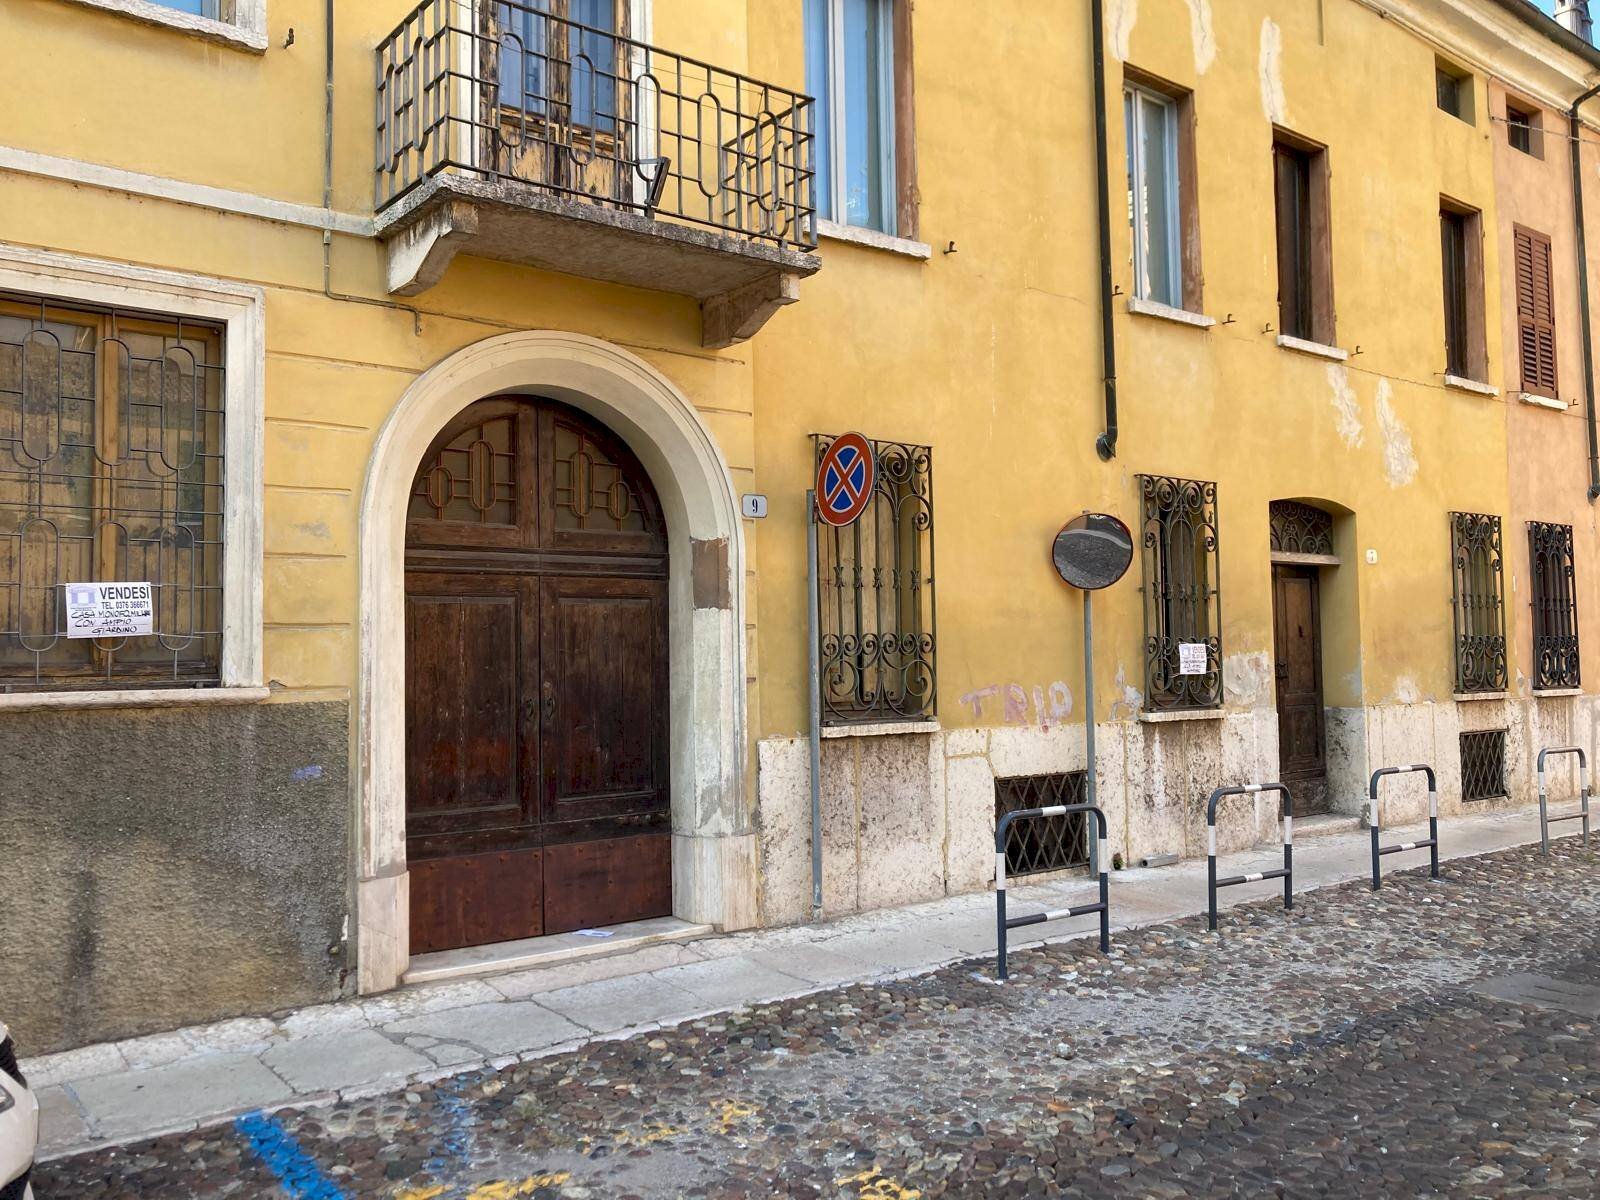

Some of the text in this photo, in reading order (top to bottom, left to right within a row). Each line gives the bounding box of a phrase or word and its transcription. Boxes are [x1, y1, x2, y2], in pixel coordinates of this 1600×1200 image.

[752, 498, 758, 513] 9
[100, 587, 149, 599] VENDESI
[75, 618, 95, 628] CON
[92, 626, 137, 634] GIARDINO
